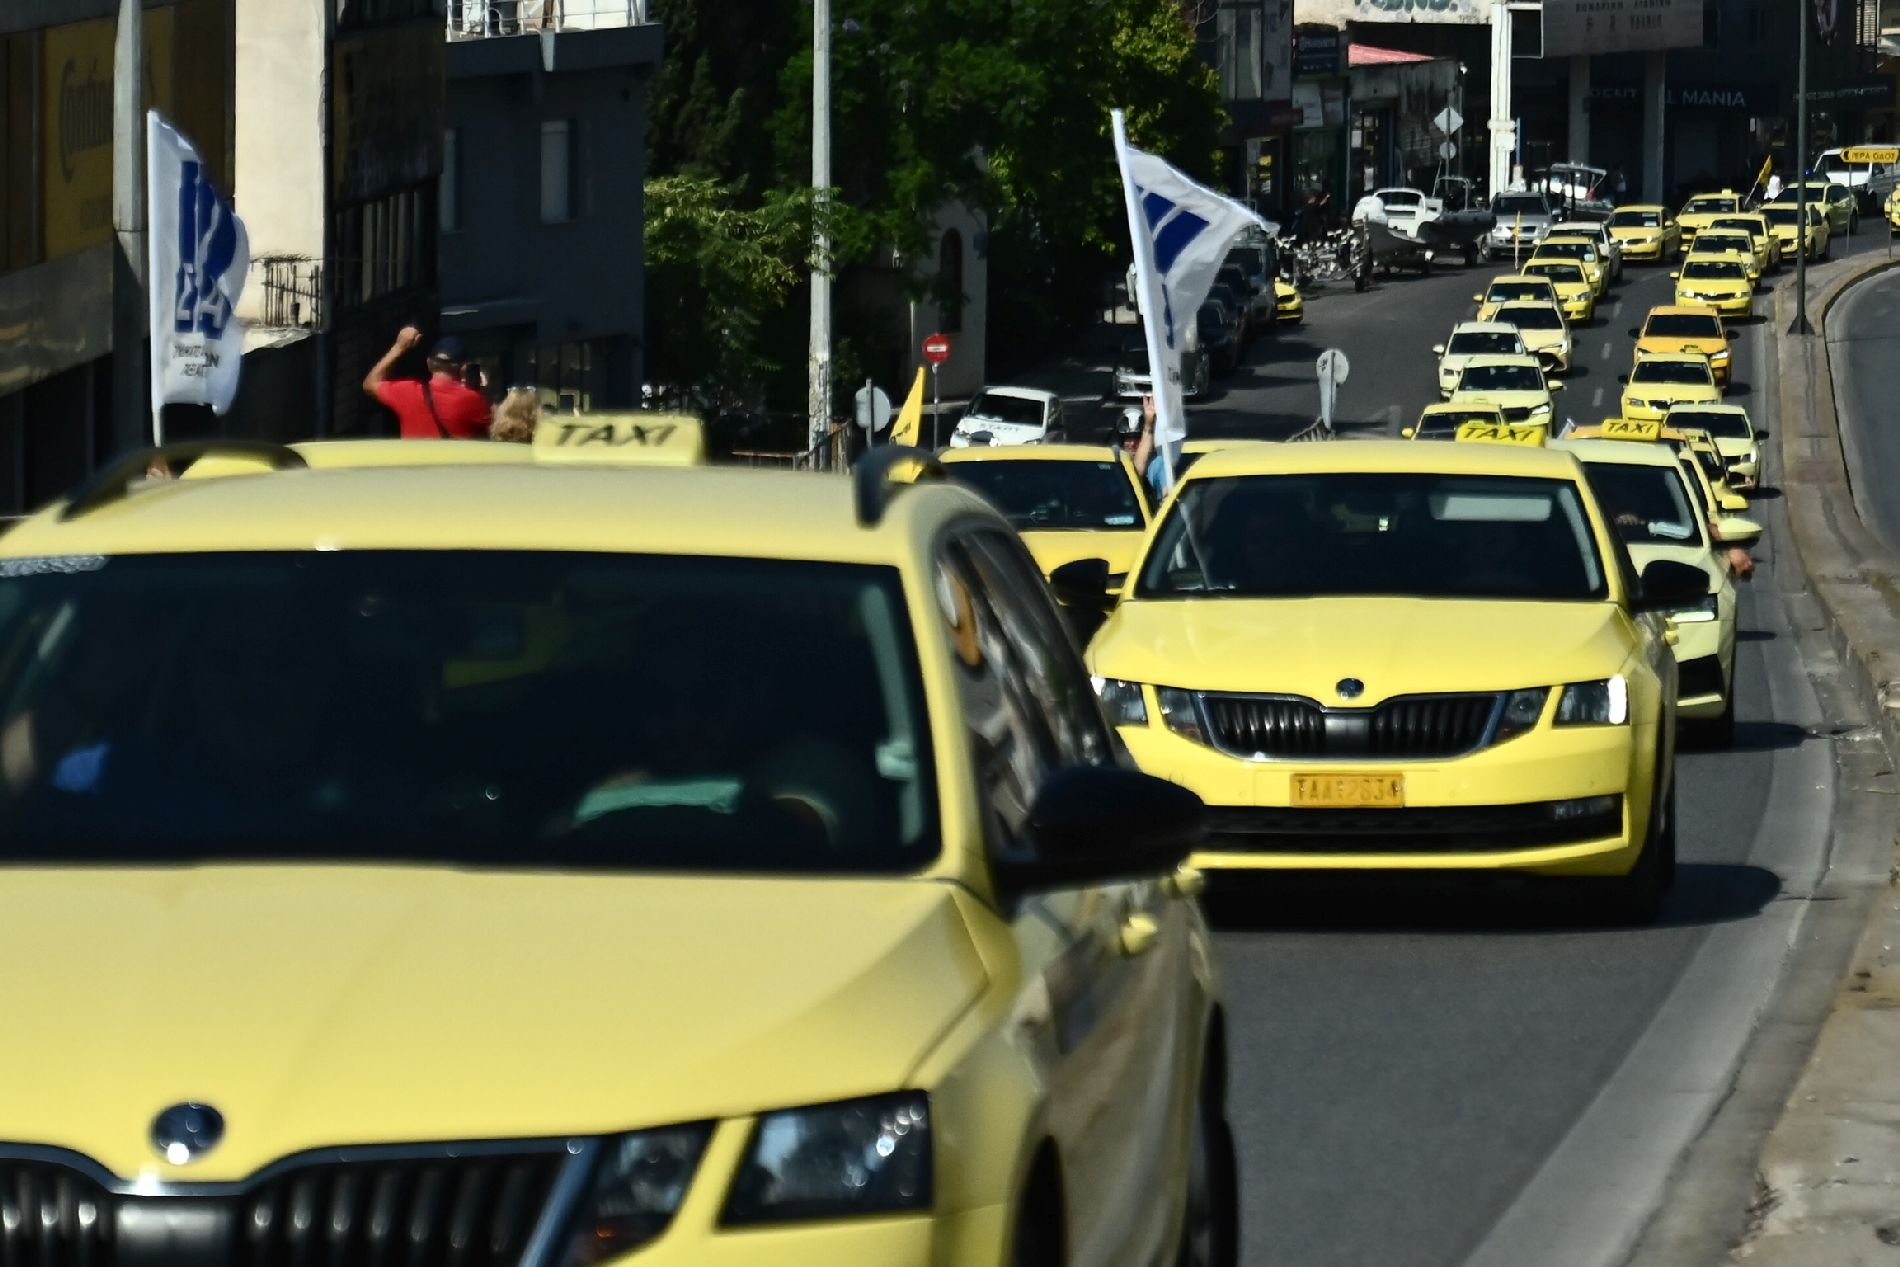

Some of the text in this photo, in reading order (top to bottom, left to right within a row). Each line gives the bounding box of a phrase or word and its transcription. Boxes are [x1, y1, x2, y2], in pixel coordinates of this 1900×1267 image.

[1682, 89, 1746, 107] MANIA
[555, 424, 678, 447] TAXI
[1464, 426, 1534, 442] TAXI
[1606, 421, 1654, 434] TAXI
